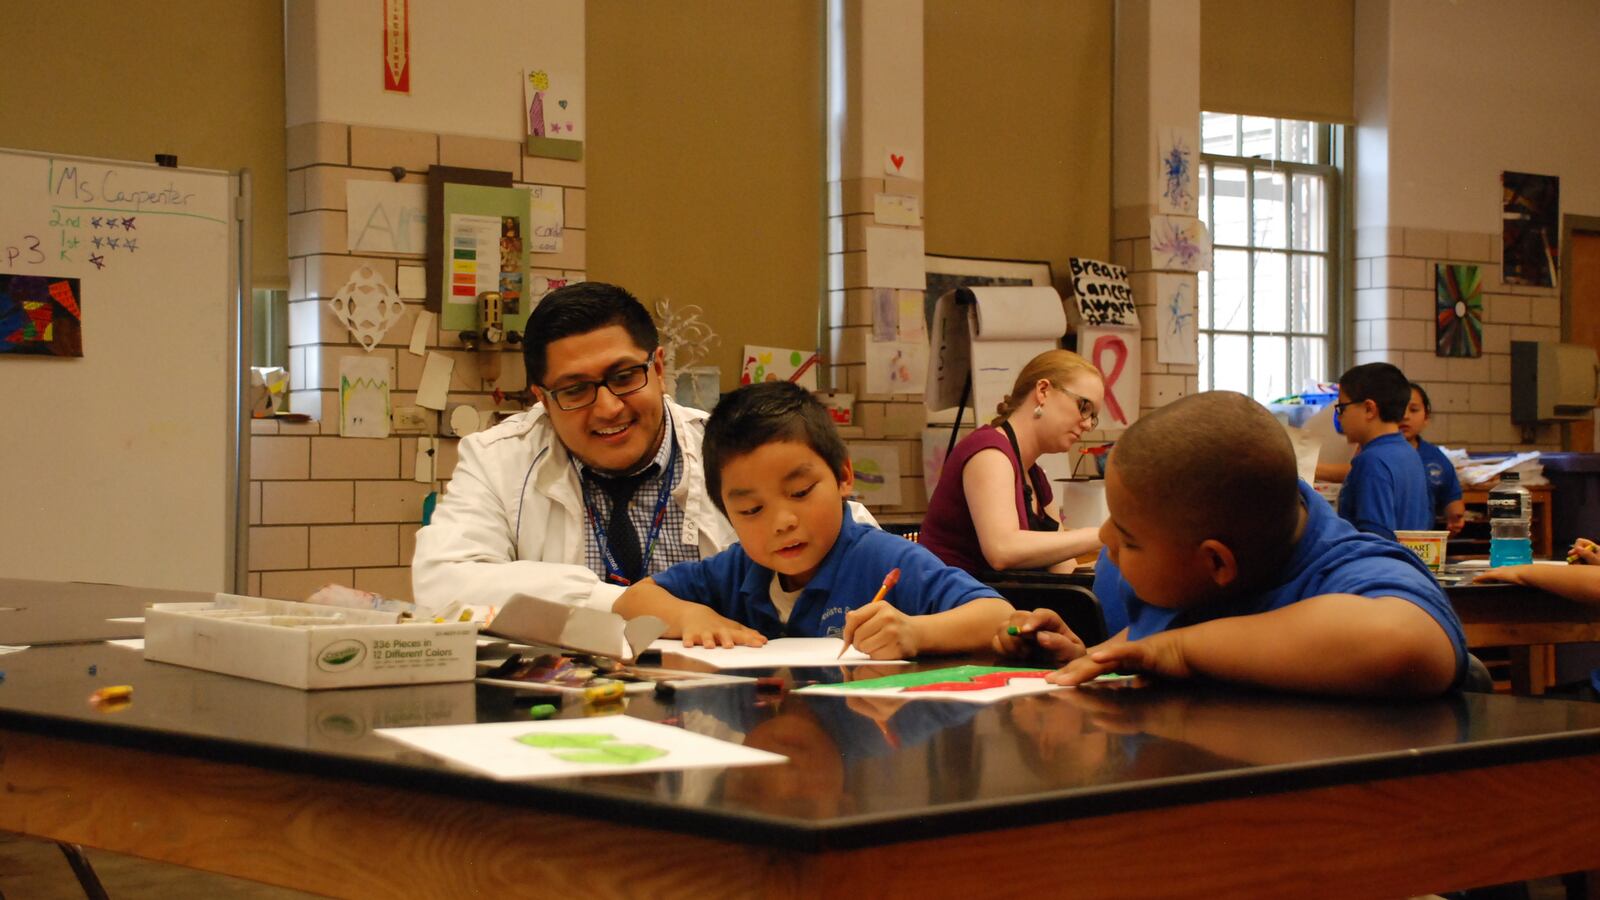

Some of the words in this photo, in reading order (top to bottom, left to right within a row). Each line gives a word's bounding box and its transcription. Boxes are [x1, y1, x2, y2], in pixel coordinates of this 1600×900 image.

[56, 166, 94, 203] Ms
[102, 169, 195, 212] Carpenter
[49, 209, 80, 227] 2nd
[61, 229, 80, 249] 1st
[1069, 257, 1127, 281] Breast
[1074, 277, 1131, 302] Cancer
[373, 640, 390, 649] 336
[393, 639, 421, 648] Pieces
[423, 638, 432, 647] in
[373, 650, 382, 659] 12
[385, 649, 423, 659] Different
[425, 648, 453, 657] Colors
